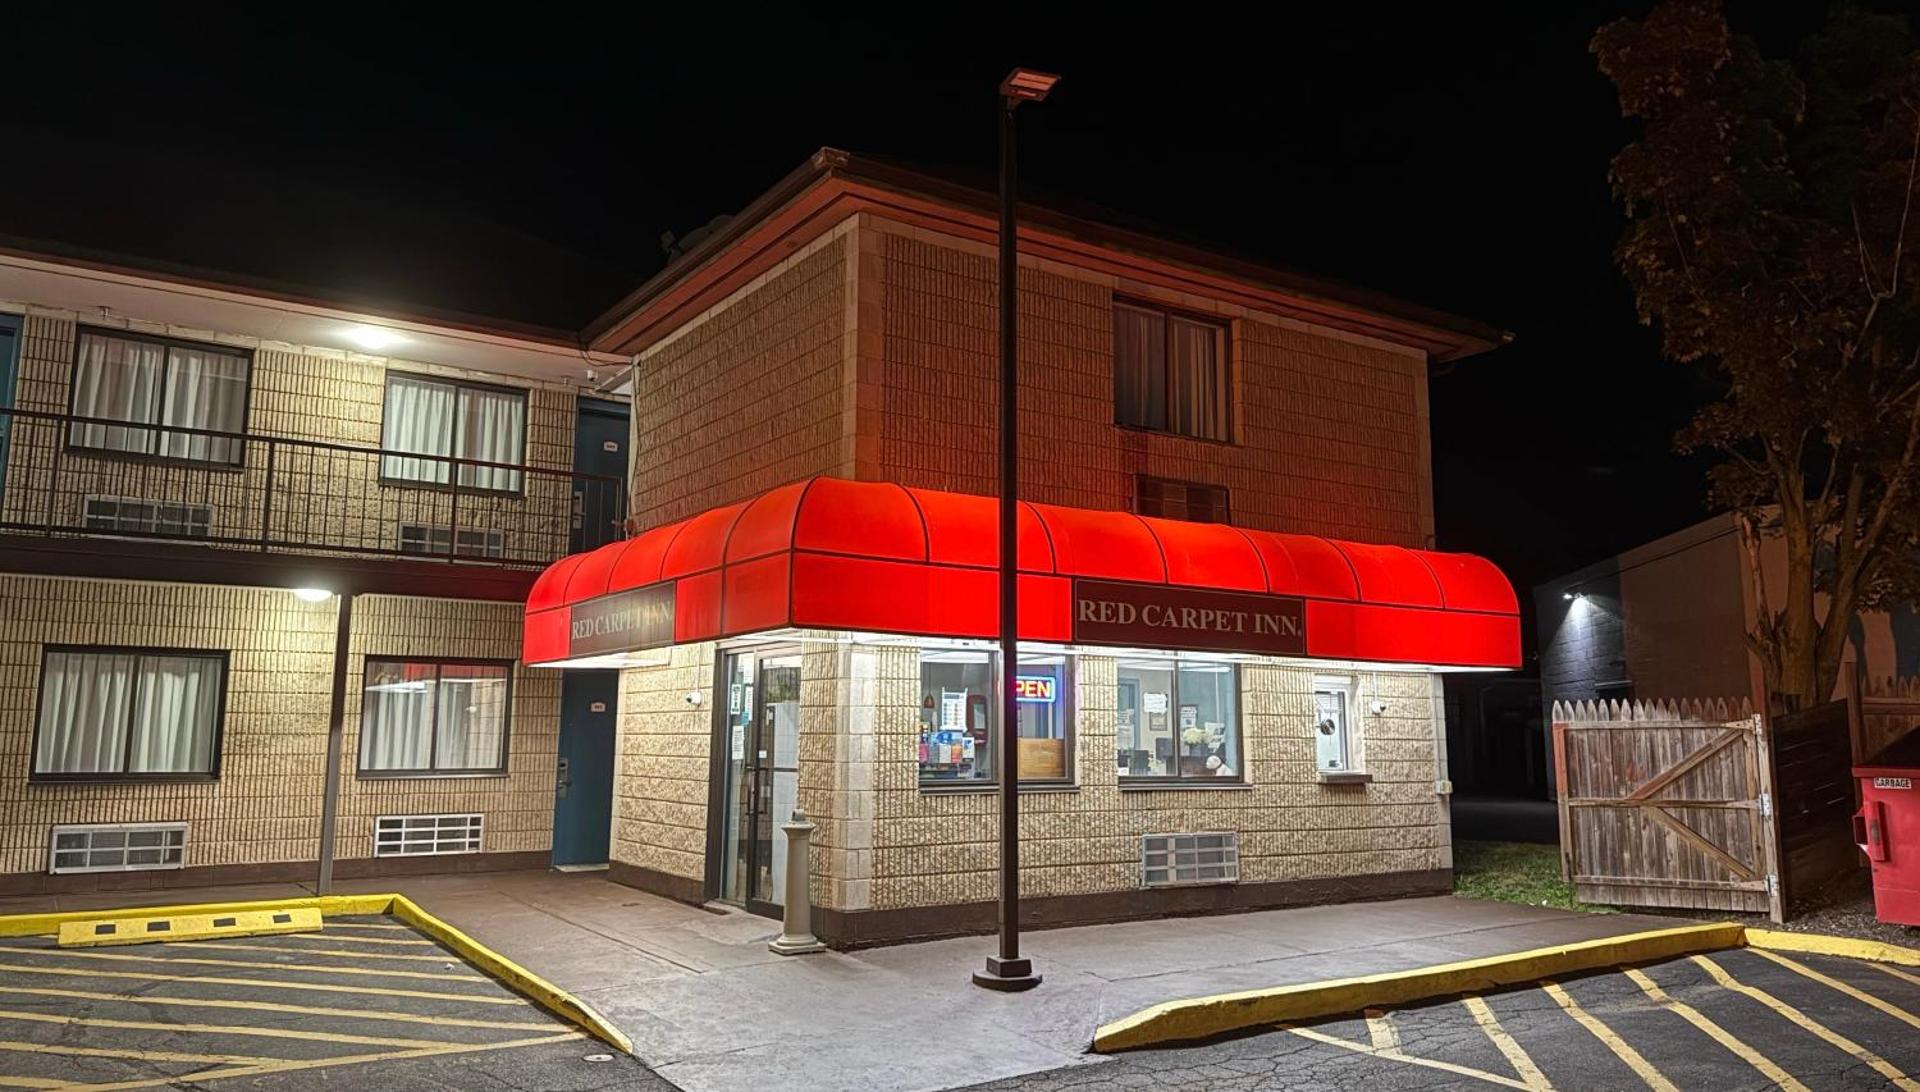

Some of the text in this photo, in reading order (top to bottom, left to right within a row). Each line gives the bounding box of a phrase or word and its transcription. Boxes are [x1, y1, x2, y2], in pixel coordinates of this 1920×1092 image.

[572, 618, 594, 640] RED
[595, 606, 643, 636] CARPET
[1079, 600, 1136, 624] RED
[1142, 604, 1248, 632] CARPET
[1016, 680, 1051, 697] PEN
[1874, 778, 1910, 787] GARBAGE
